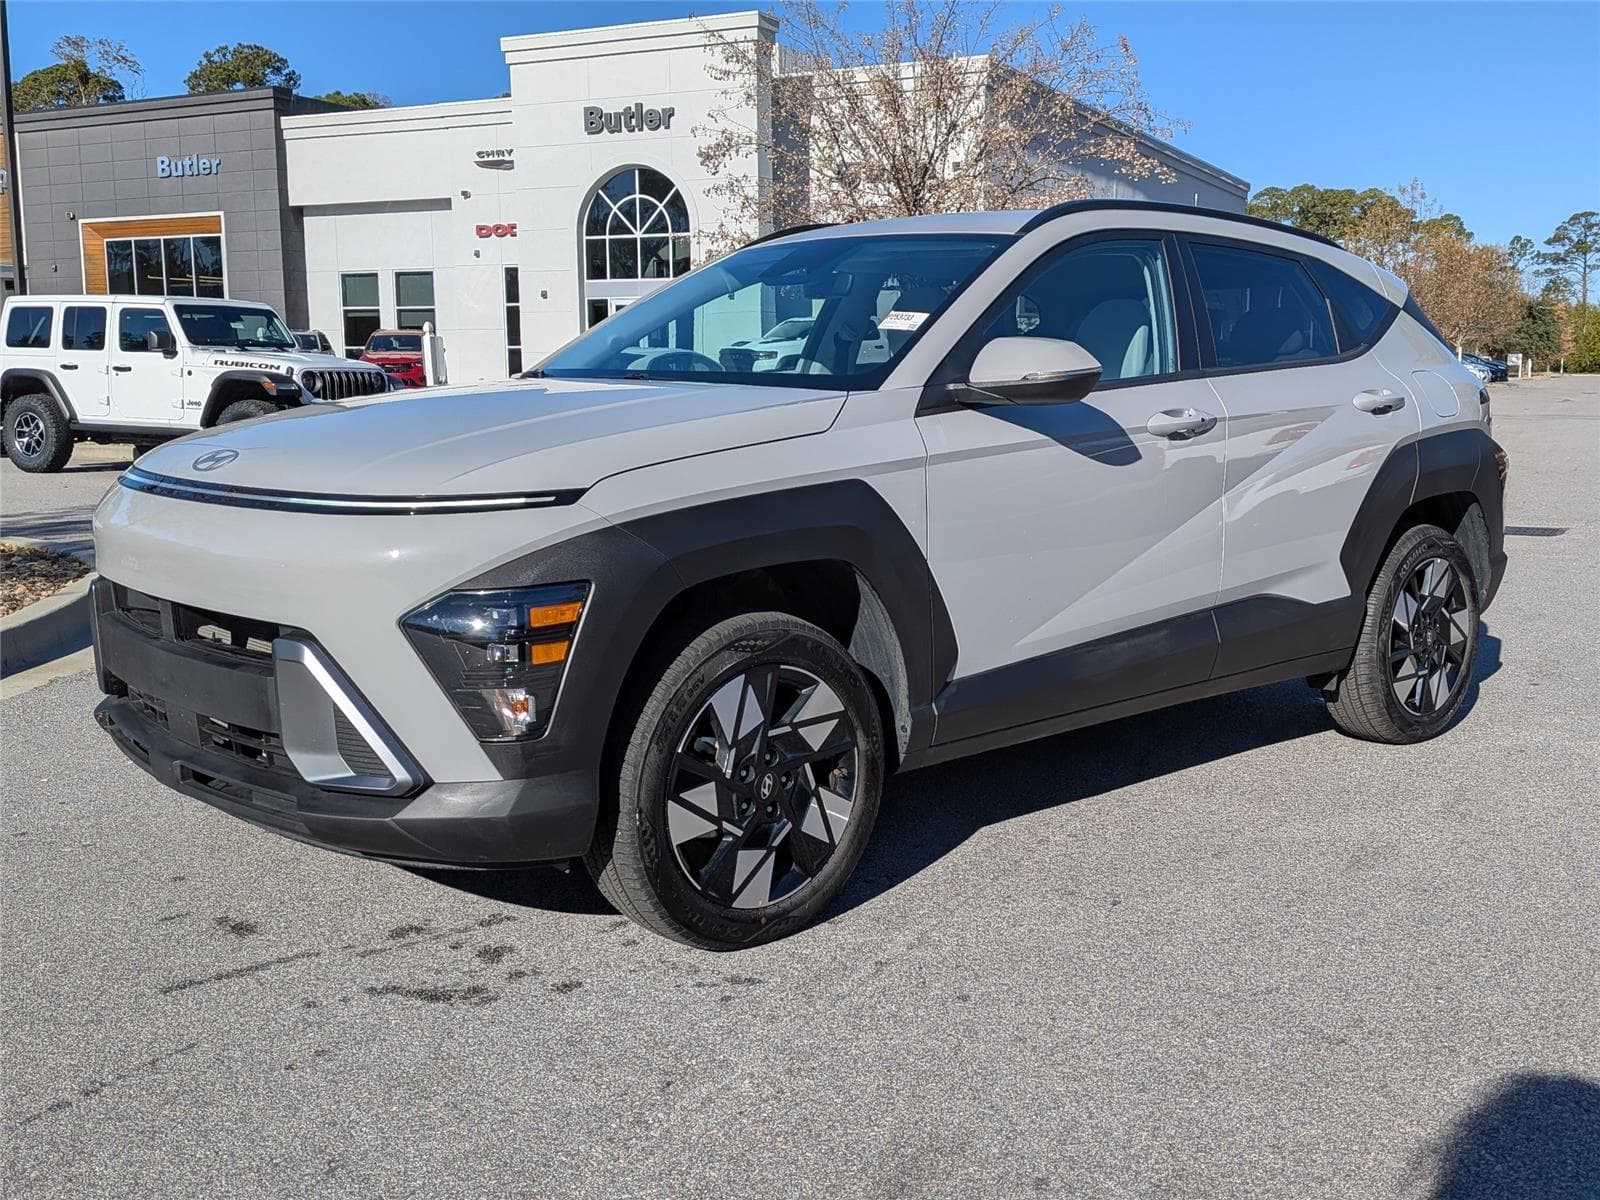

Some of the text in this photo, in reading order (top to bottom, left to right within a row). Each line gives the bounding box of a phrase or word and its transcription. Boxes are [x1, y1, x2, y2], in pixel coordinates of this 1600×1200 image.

[583, 102, 675, 135] Butler
[156, 154, 221, 179] Butler
[214, 359, 281, 371] RUBICON
[186, 399, 202, 407] Jeep
[1398, 543, 1429, 578] KUMHO
